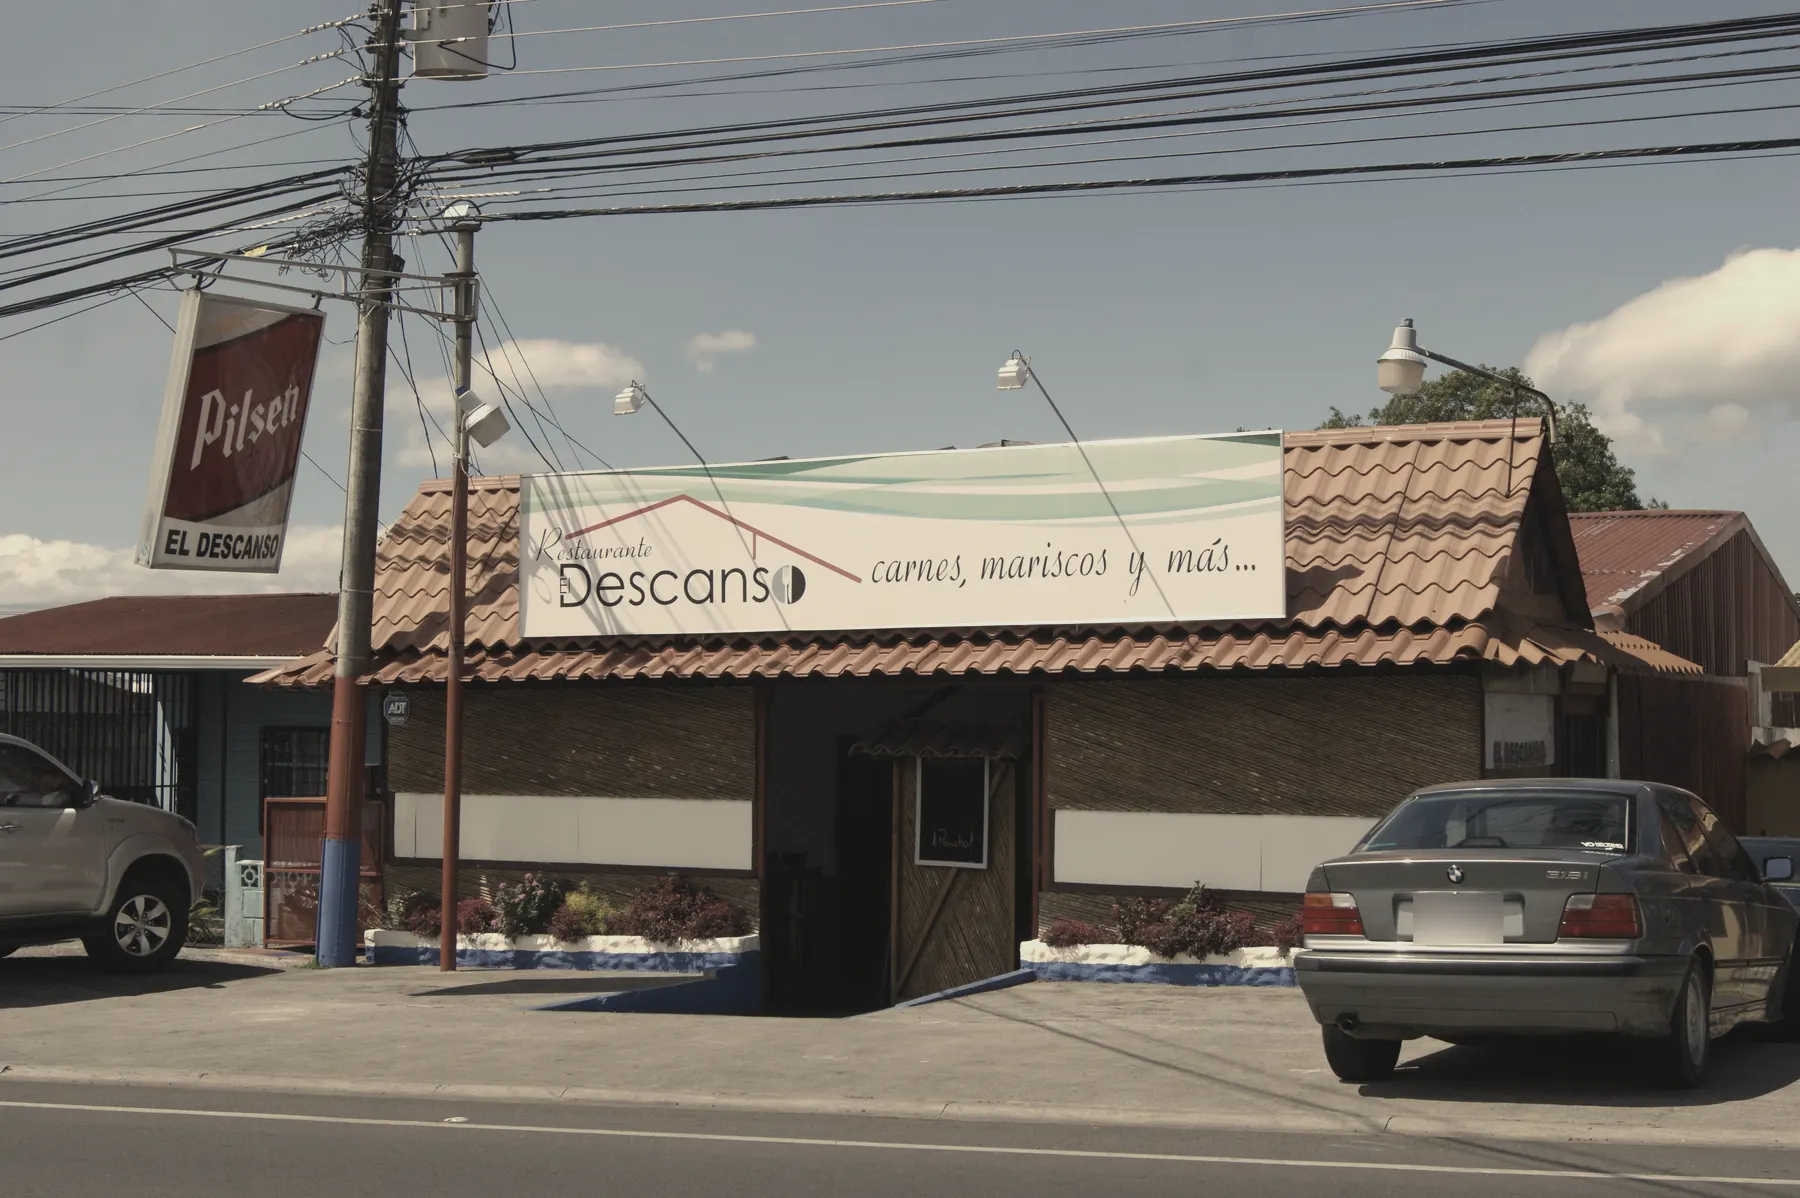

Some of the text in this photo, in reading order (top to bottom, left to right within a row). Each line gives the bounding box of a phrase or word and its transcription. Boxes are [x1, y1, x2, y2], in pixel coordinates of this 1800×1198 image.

[190, 385, 299, 471] Pilsen
[164, 529, 279, 560] EL DESCANSO
[536, 526, 653, 562] Restaurante
[871, 537, 1257, 597] carnes, mariscos y más...
[388, 702, 407, 714] ADT
